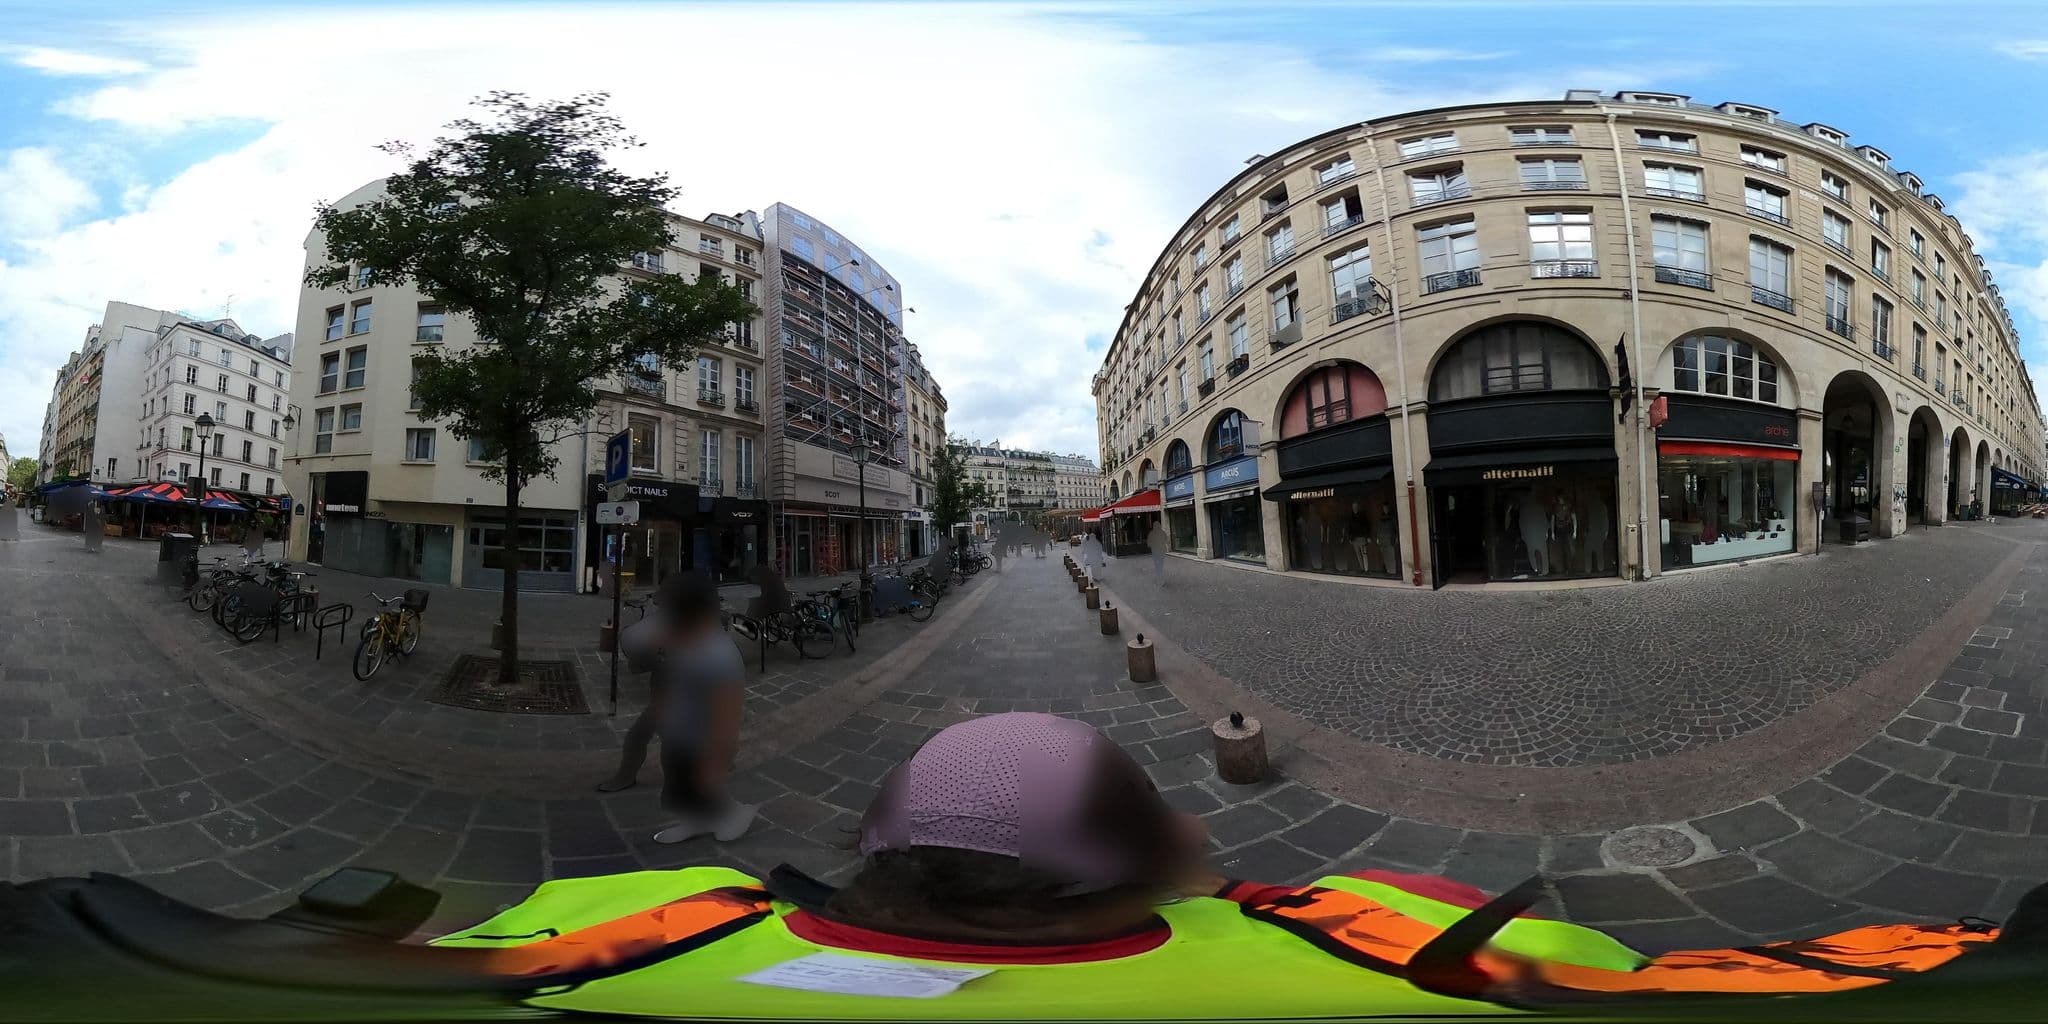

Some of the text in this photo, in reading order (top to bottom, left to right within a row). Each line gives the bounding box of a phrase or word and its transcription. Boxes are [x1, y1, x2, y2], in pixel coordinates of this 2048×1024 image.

[1765, 426, 1788, 437] arche
[1221, 467, 1240, 479] ARCUS
[1482, 466, 1553, 479] alternatif
[644, 487, 668, 497] NAILS
[1290, 488, 1335, 500] alternatif
